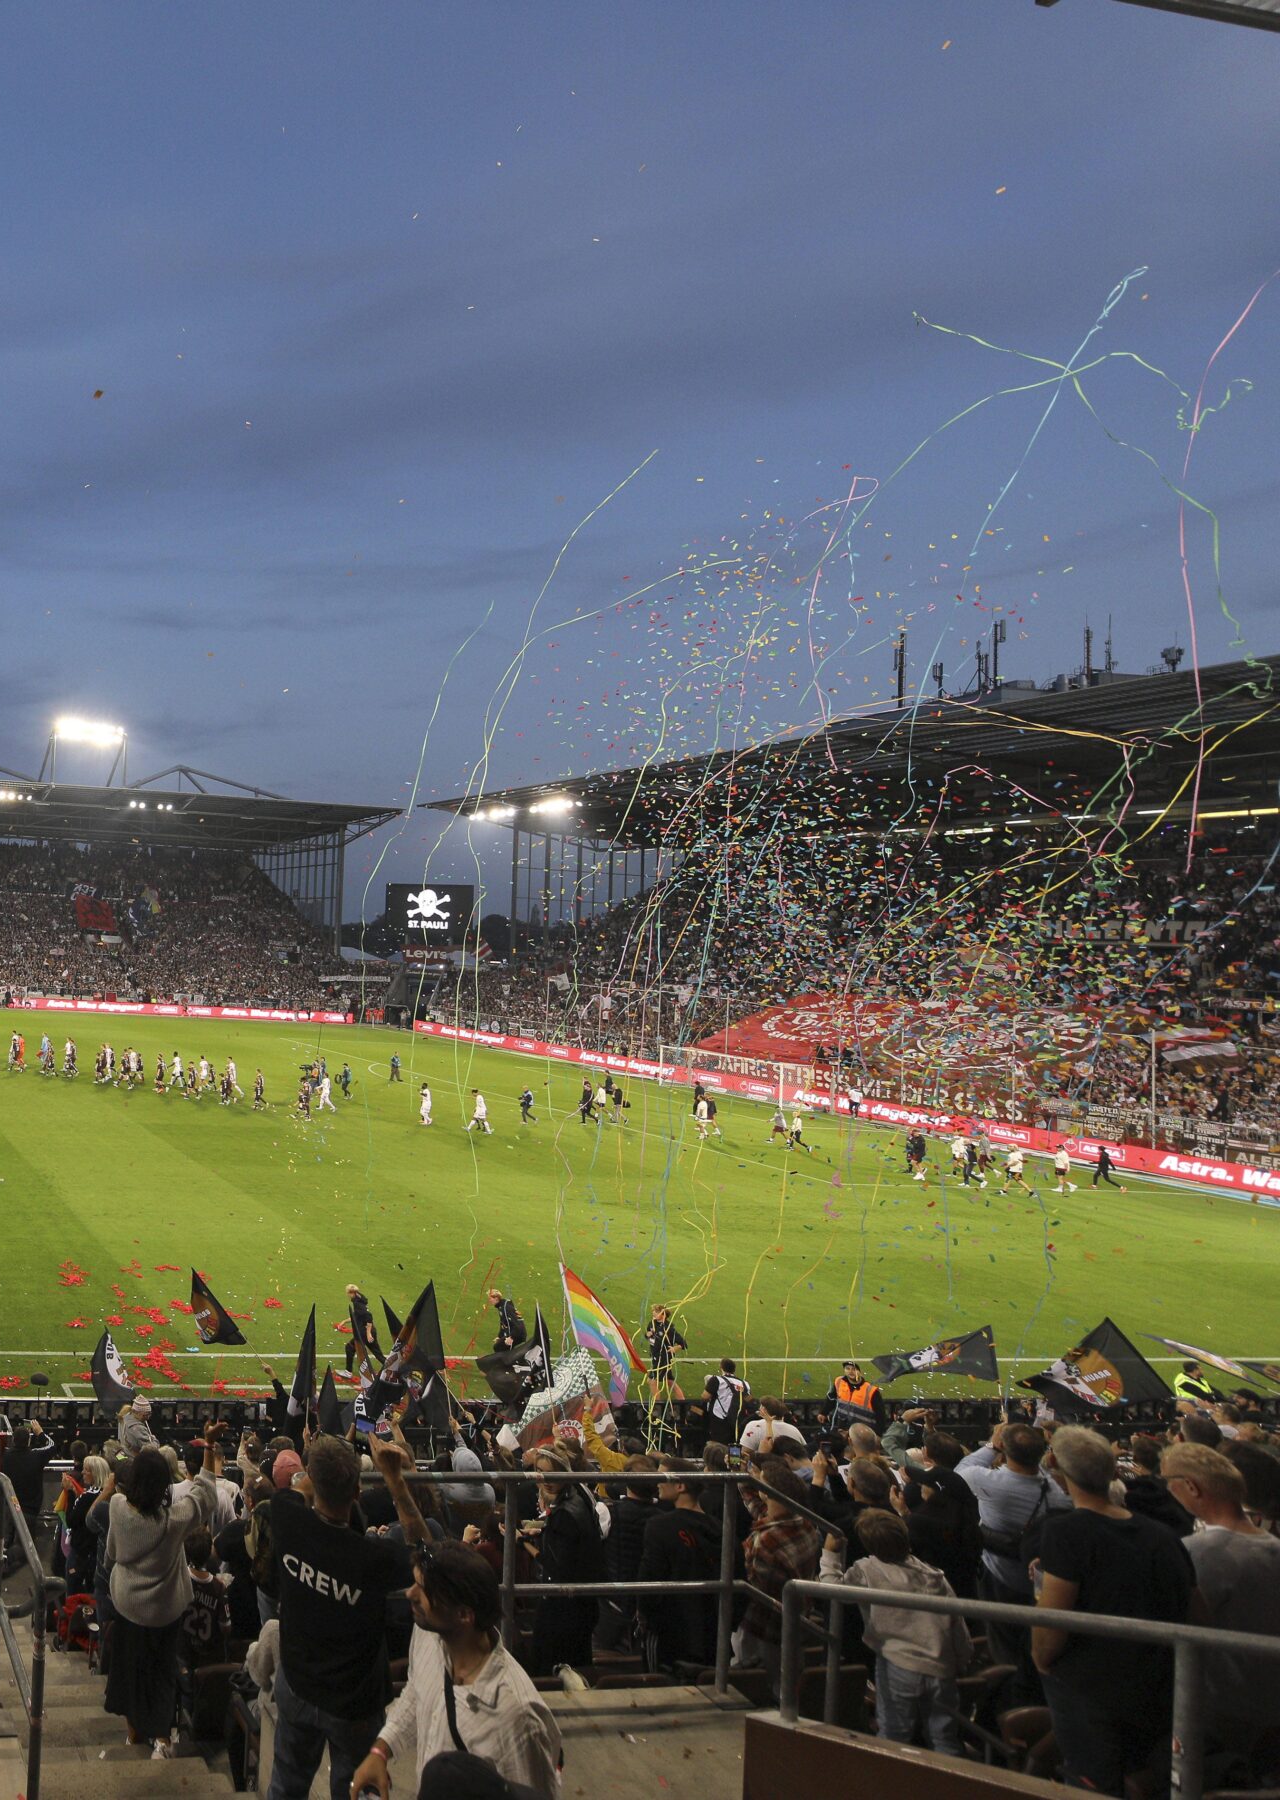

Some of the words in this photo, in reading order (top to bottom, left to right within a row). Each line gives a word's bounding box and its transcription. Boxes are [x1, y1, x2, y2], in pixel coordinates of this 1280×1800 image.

[407, 920, 419, 928] ST.
[421, 920, 448, 929] PAULI
[405, 949, 447, 960] Levi's
[580, 1051, 604, 1064] Astra.
[606, 1056, 626, 1067] Was
[627, 1060, 675, 1076] dagegen?
[750, 1084, 773, 1094] ASTRA
[794, 1090, 831, 1106] Astra.
[837, 1098, 868, 1113] Ws
[993, 1128, 1026, 1140] ASTRA
[1082, 1144, 1121, 1158] ASRA
[1159, 1155, 1234, 1182] Astra.
[282, 1553, 362, 1606] CREW
